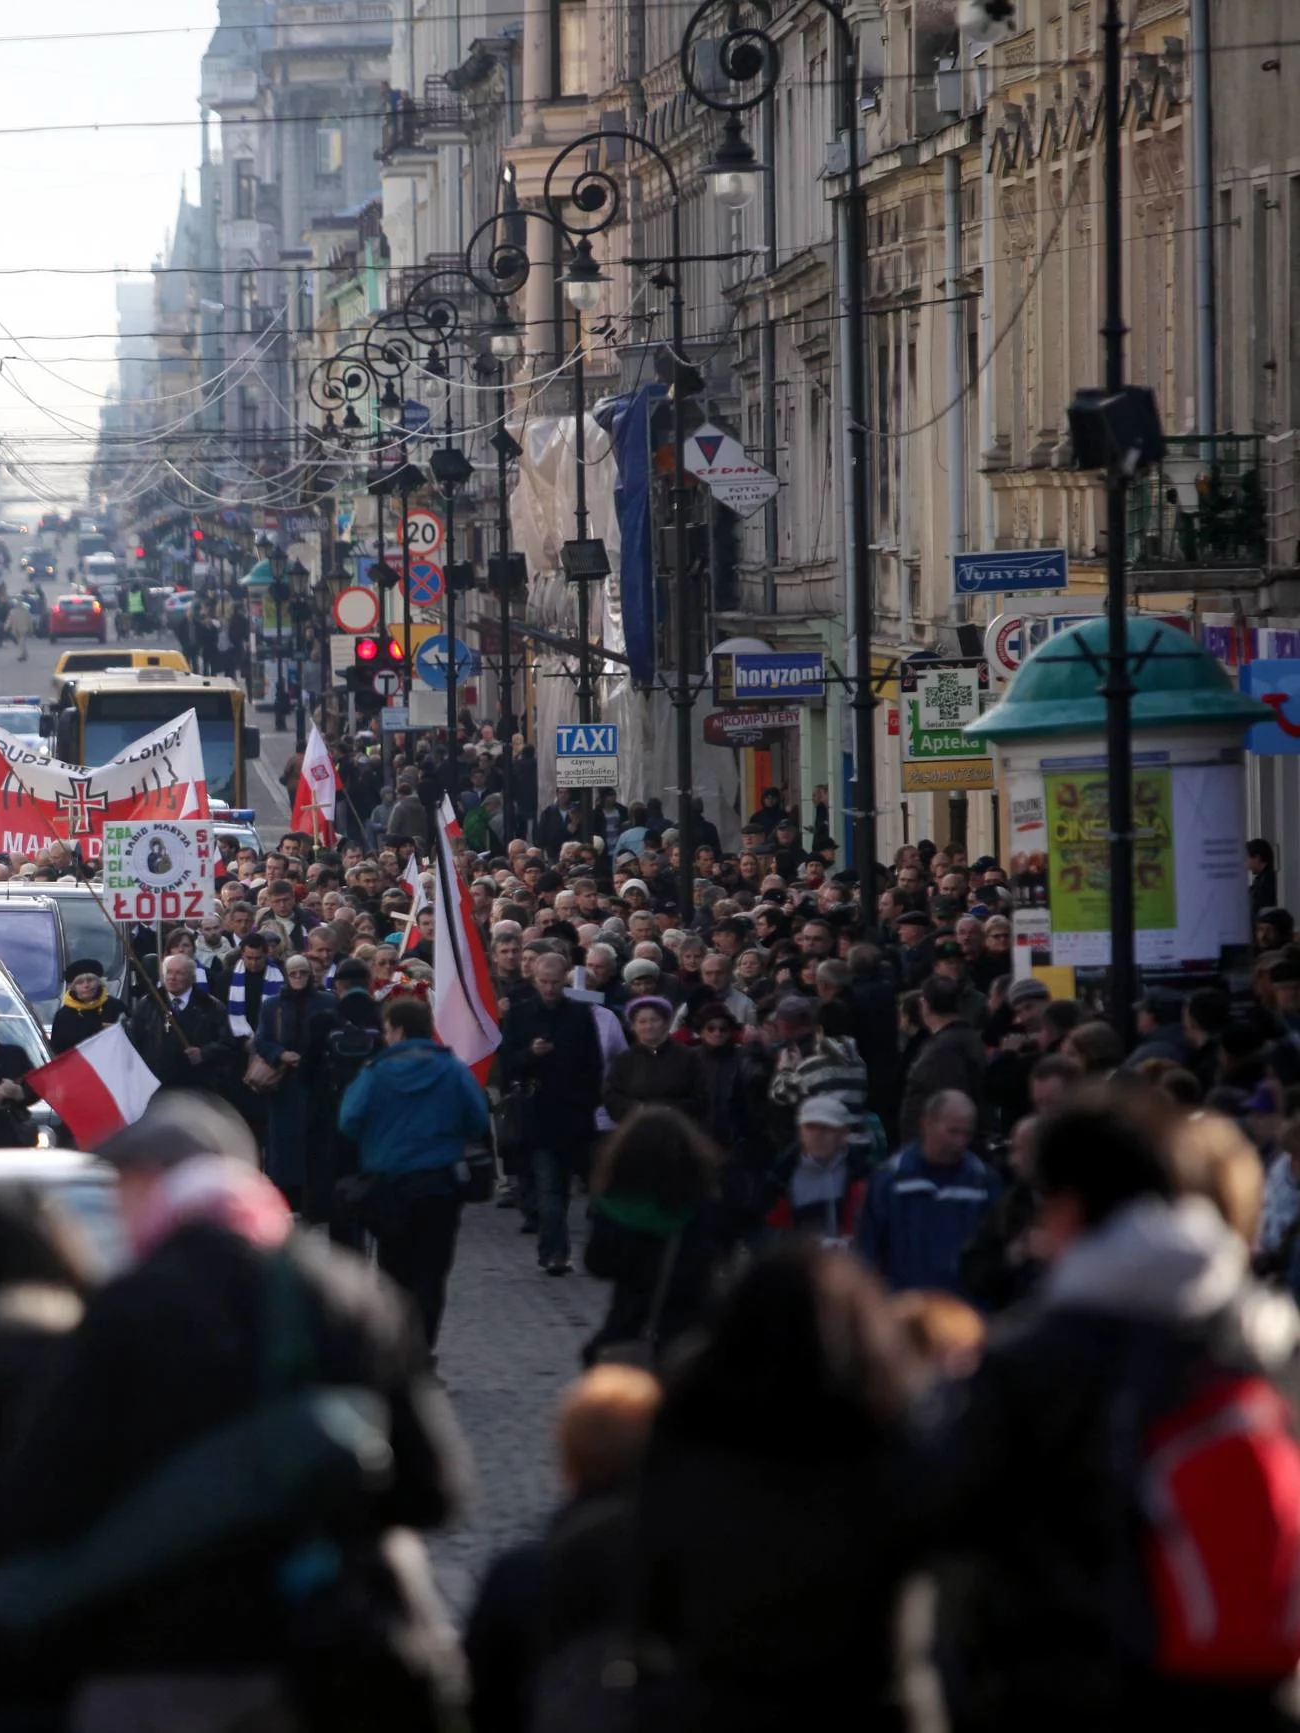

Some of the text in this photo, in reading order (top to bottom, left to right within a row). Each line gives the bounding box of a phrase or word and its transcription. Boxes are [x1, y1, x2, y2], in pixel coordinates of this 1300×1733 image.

[407, 522, 436, 544] 20
[736, 663, 822, 689] horyzont
[723, 712, 800, 726] KOMPUTERY
[557, 728, 614, 752] TAXI
[920, 735, 980, 753] Apteka
[125, 823, 192, 856] RADIO MARYJA
